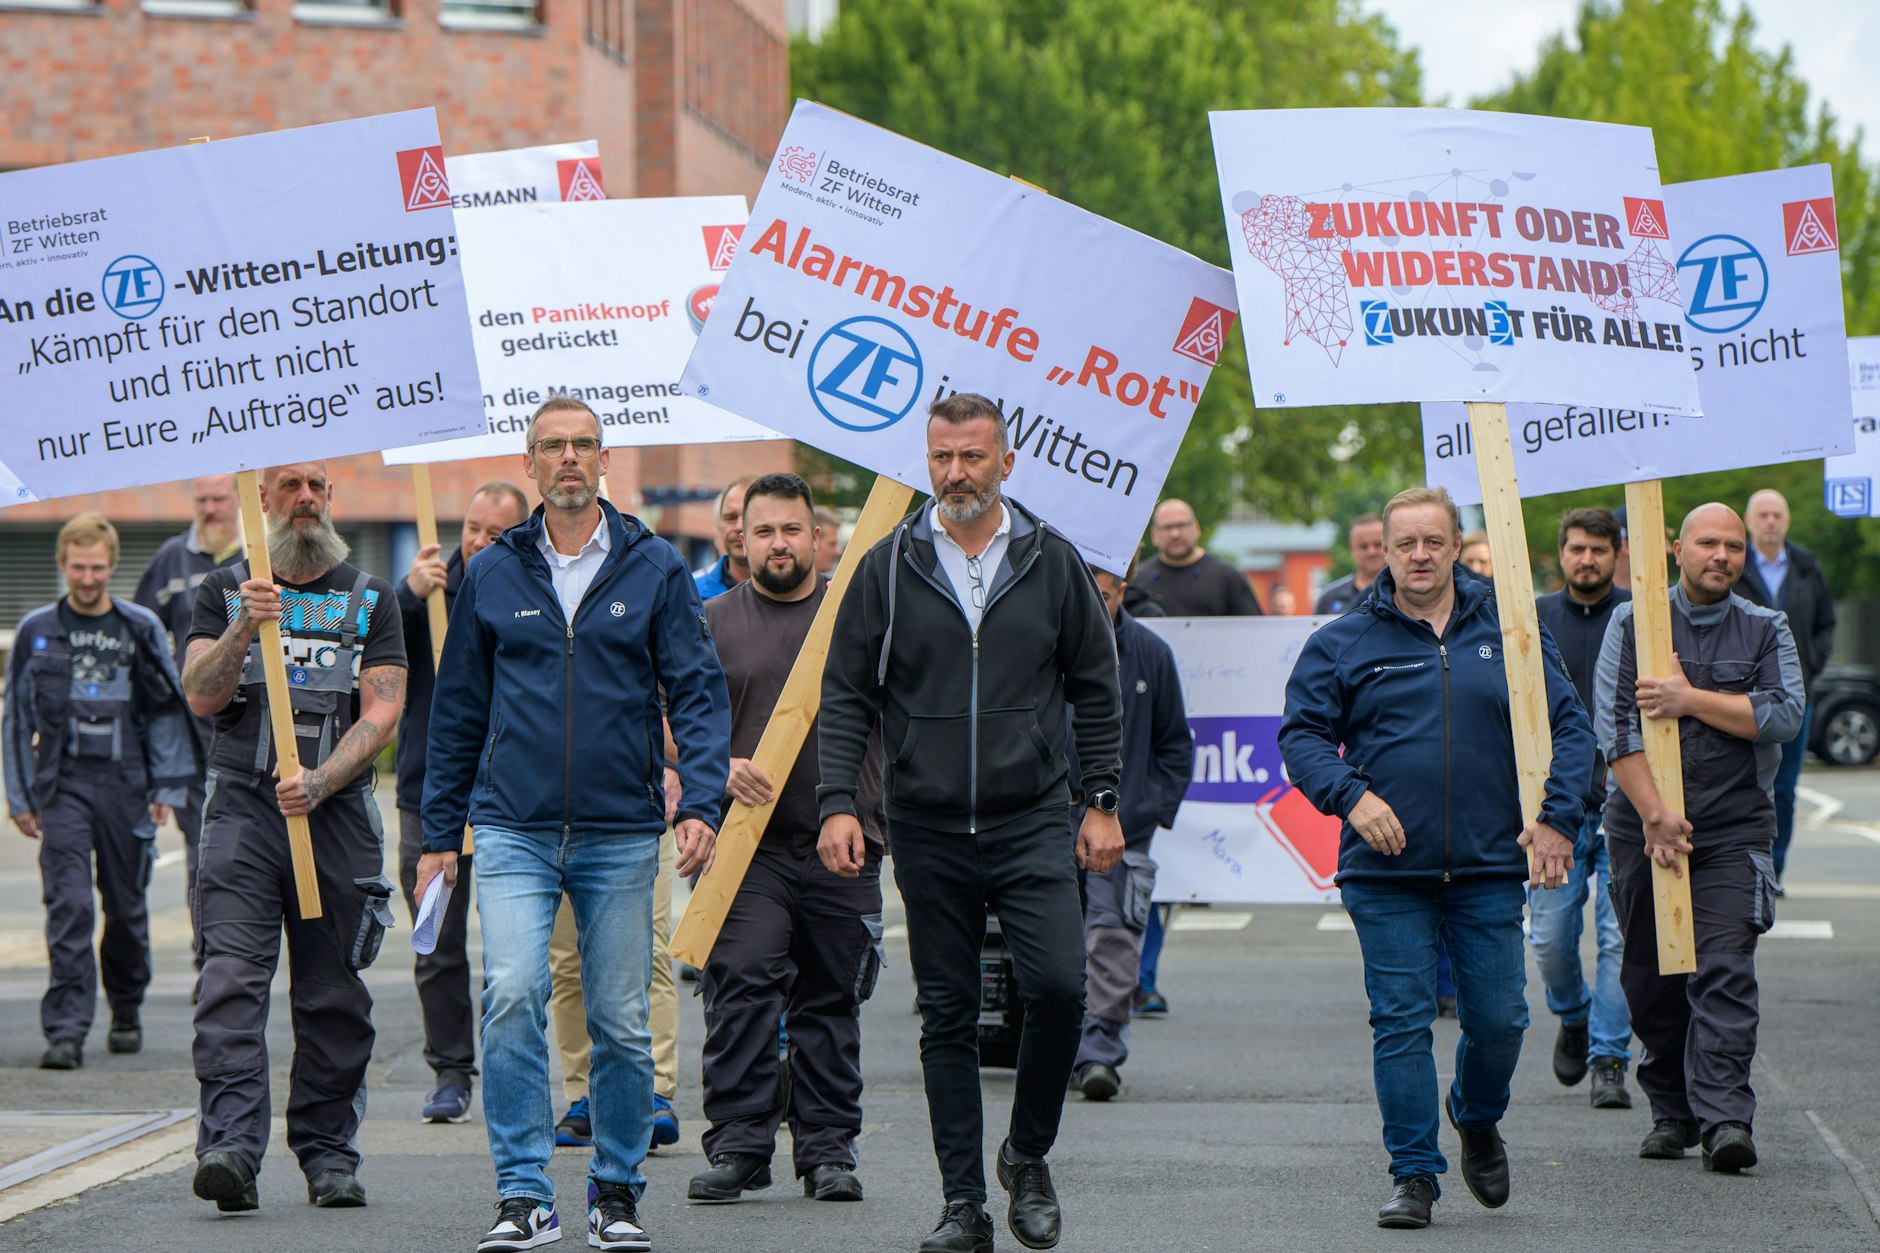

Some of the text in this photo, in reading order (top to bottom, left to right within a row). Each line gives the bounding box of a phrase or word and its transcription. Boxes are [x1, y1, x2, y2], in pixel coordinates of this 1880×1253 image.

[451, 186, 538, 209] ESMANN
[781, 182, 814, 201] Modern,
[816, 195, 837, 209] aktiv
[845, 206, 884, 226] innovativ
[820, 177, 902, 219] ZF Witten
[827, 160, 920, 206] Betriebsrat
[8, 208, 107, 235] Betriebsrat
[11, 230, 100, 254] ZF Witten
[1305, 201, 1626, 250] ZUKUNFT ODER
[47, 250, 89, 262] innovativ
[1341, 250, 1633, 299] WIDERSTAND!
[0, 235, 458, 325] An die ZF -Witten-Leitung:
[749, 218, 1041, 363] Alarmstufe
[1676, 234, 1769, 334] ZF
[161, 317, 205, 350] für
[219, 306, 280, 340] den
[293, 279, 438, 328] Standort
[479, 300, 670, 327] den Panikknopf
[1362, 303, 1684, 353] ZUKUNFT FÜR ALLE!
[501, 329, 619, 357] gedrückt!
[1718, 328, 1807, 369] nicht
[109, 338, 358, 403] und führt nicht
[503, 387, 540, 406] die
[547, 381, 689, 403] Manageme
[37, 427, 91, 461] nur
[103, 415, 179, 452] Eure
[376, 372, 445, 411] aus!
[734, 296, 809, 359] bei
[807, 315, 923, 433] ZF
[998, 398, 1139, 497] Witten
[488, 407, 670, 434] icht aden!
[1436, 406, 1670, 459] all gefallen
[1191, 729, 1269, 784] nk.
